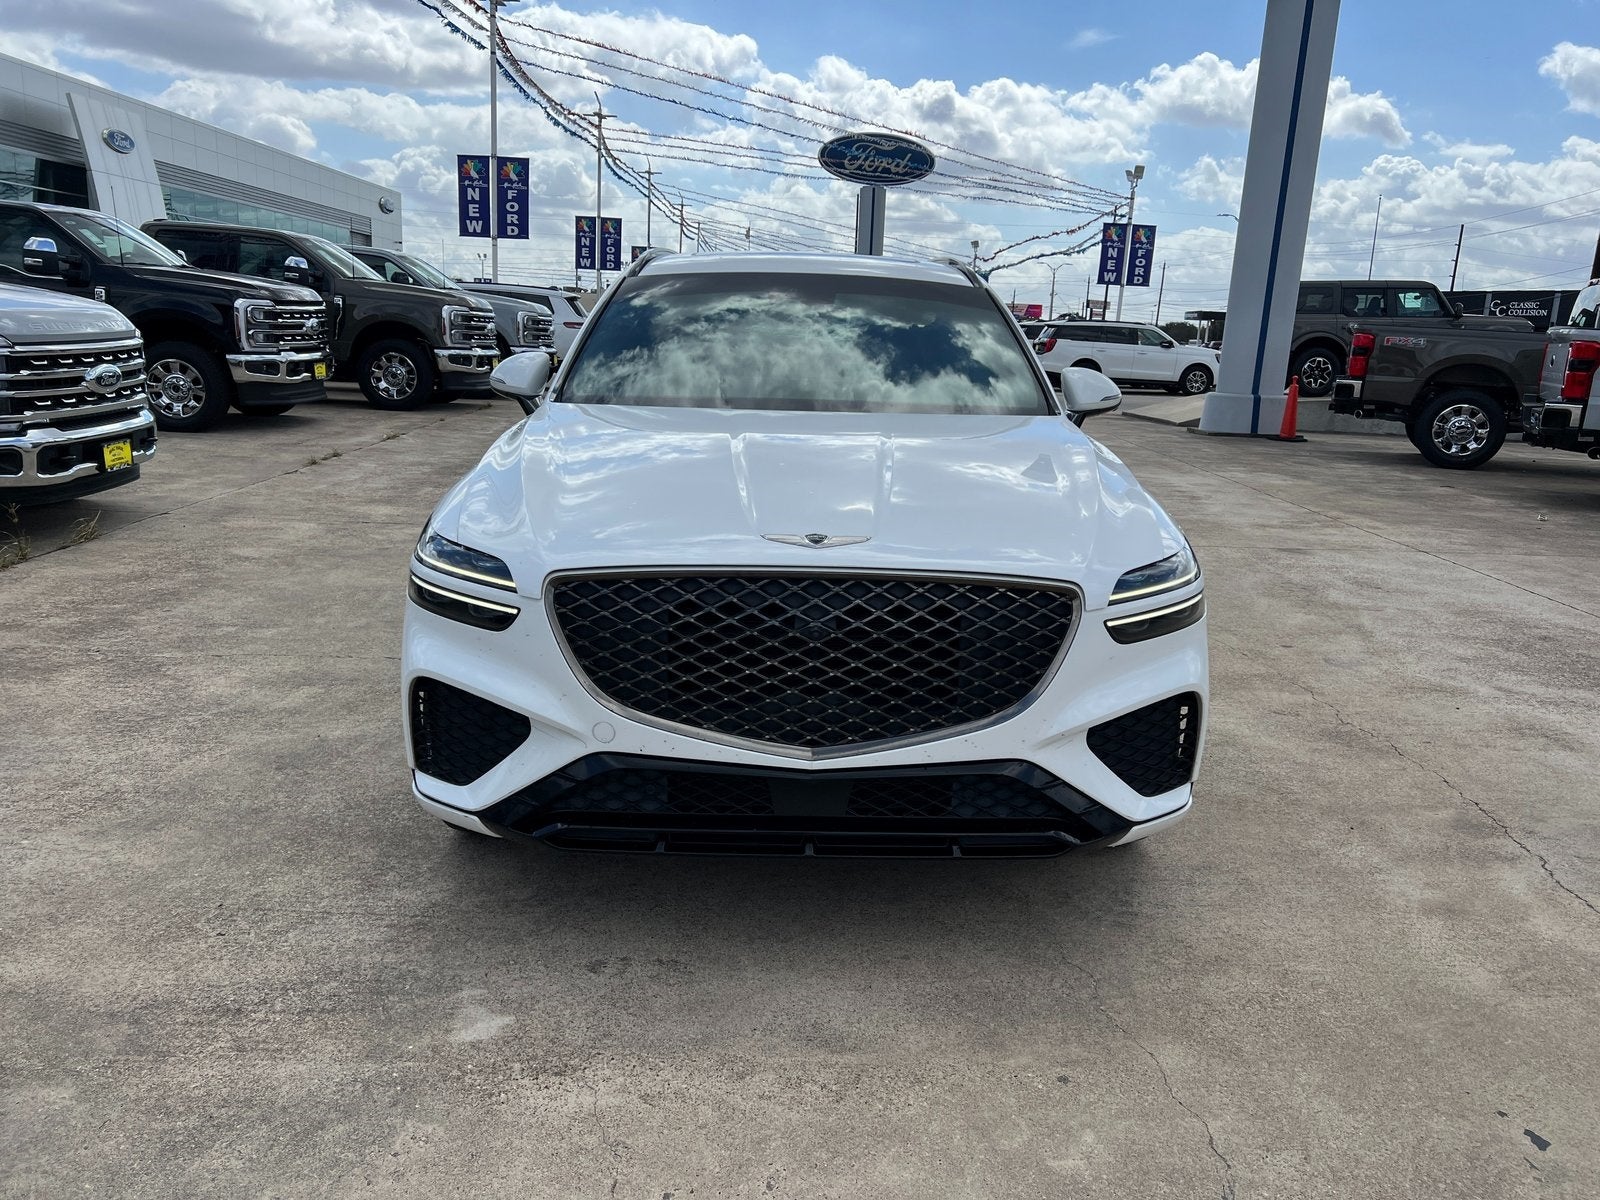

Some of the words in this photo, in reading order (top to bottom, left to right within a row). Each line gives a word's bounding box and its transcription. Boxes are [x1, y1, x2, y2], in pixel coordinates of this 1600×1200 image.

[114, 133, 131, 148] Ford
[844, 142, 912, 173] Ford
[466, 187, 483, 233] NEW
[505, 190, 519, 236] FORD
[579, 237, 591, 267] NEW
[606, 238, 615, 269] FORD
[1104, 248, 1118, 282] NEW
[1133, 249, 1146, 284] FORD
[1508, 309, 1548, 317] COLLISION
